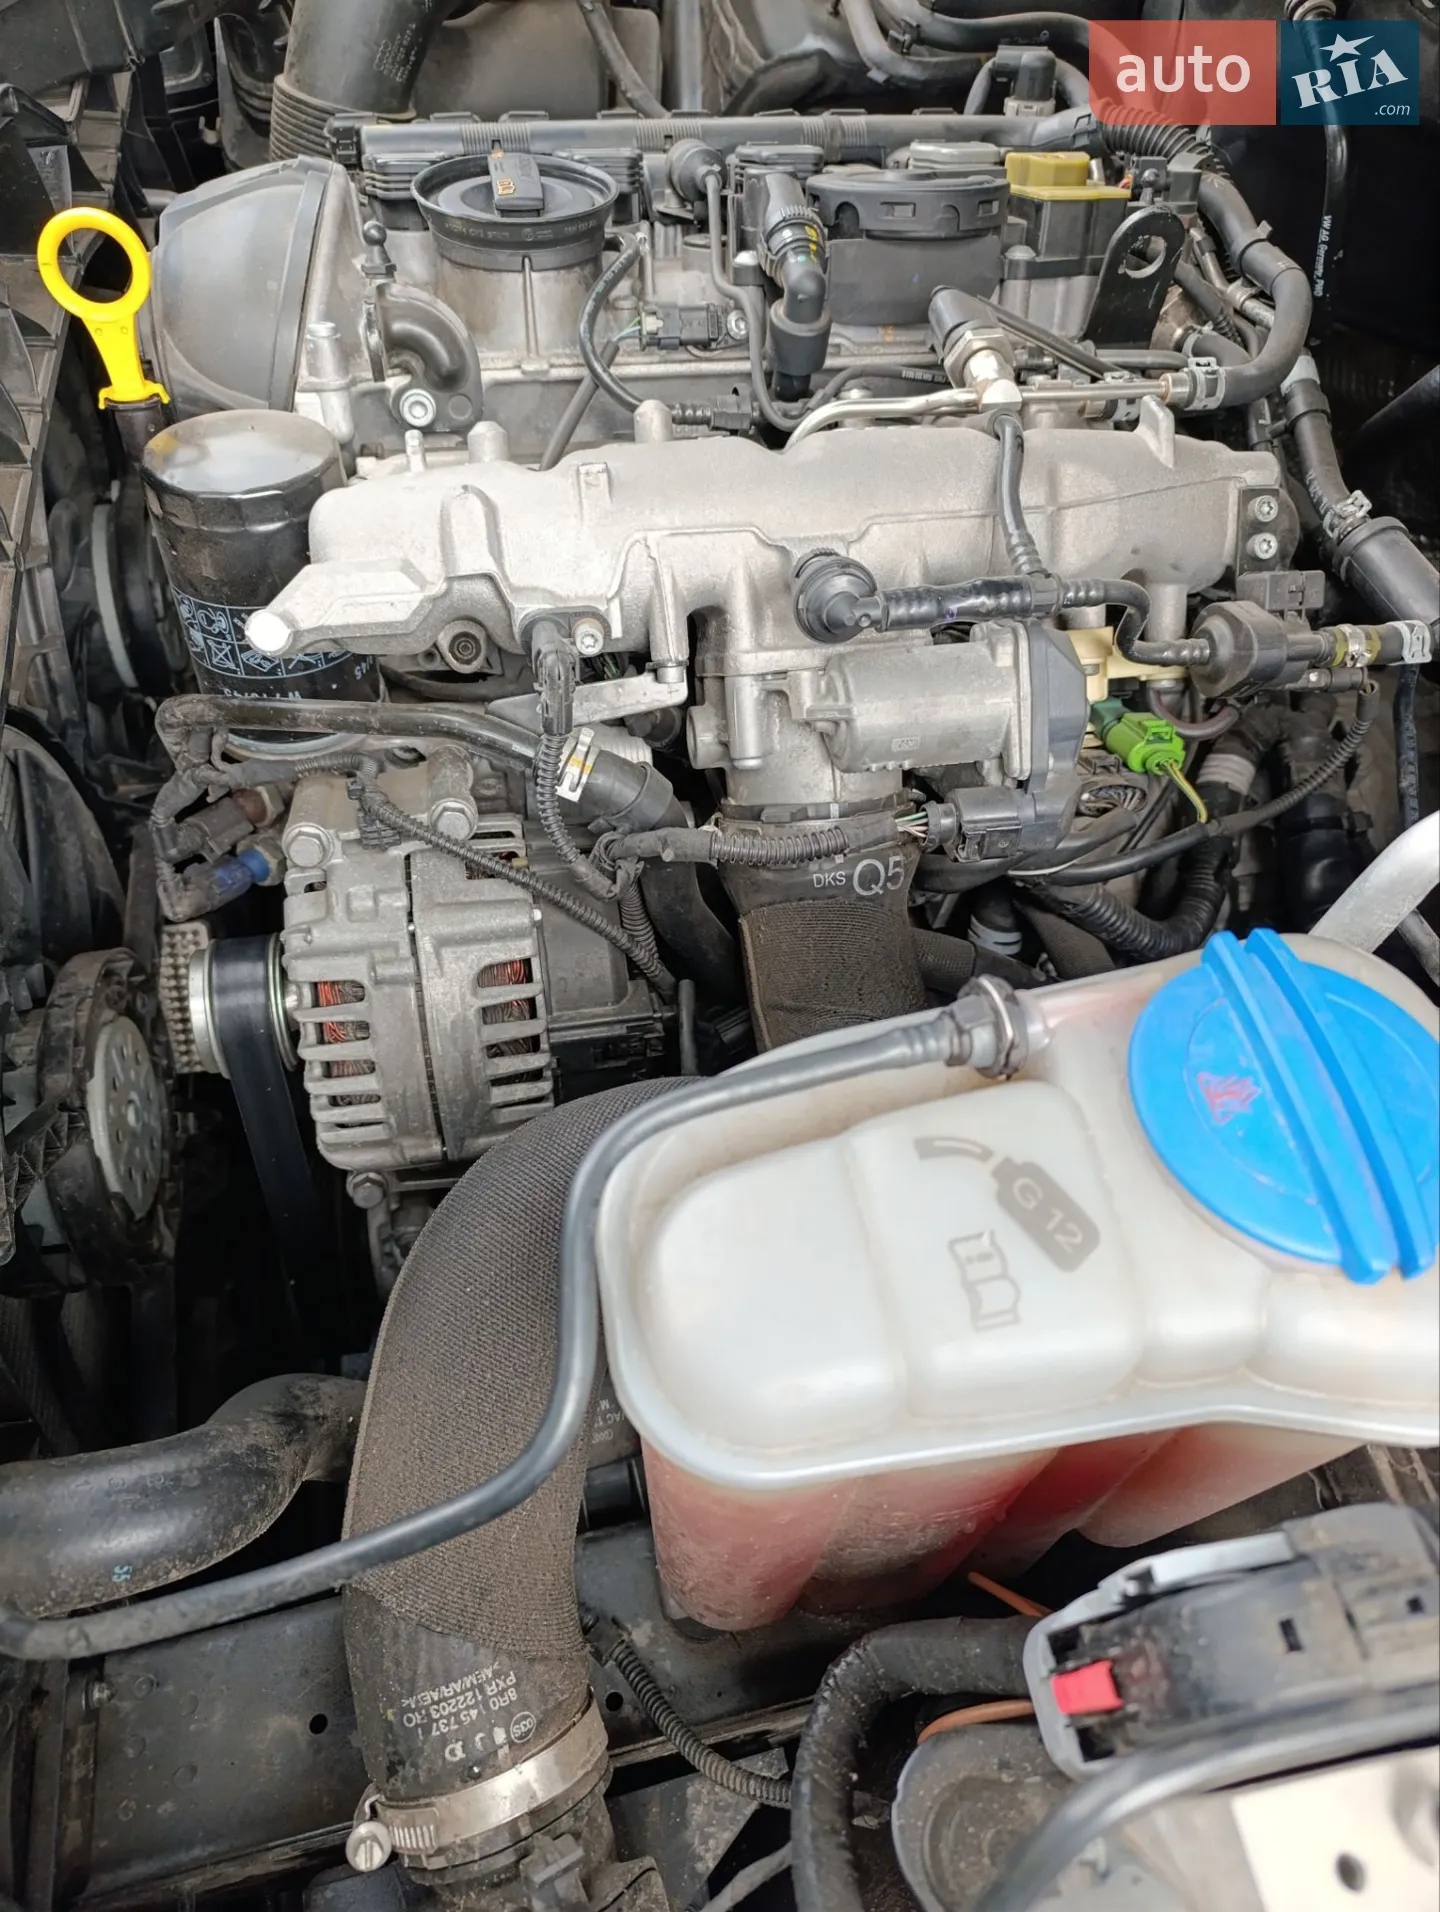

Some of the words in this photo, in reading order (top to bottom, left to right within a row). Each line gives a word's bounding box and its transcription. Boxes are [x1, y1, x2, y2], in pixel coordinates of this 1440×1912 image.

[813, 871, 847, 888] DKS
[853, 854, 905, 896] Q5
[1012, 1177, 1044, 1211] G
[1046, 1206, 1083, 1254] 12
[485, 1670, 517, 1696] PXR
[430, 1689, 483, 1720] 122203
